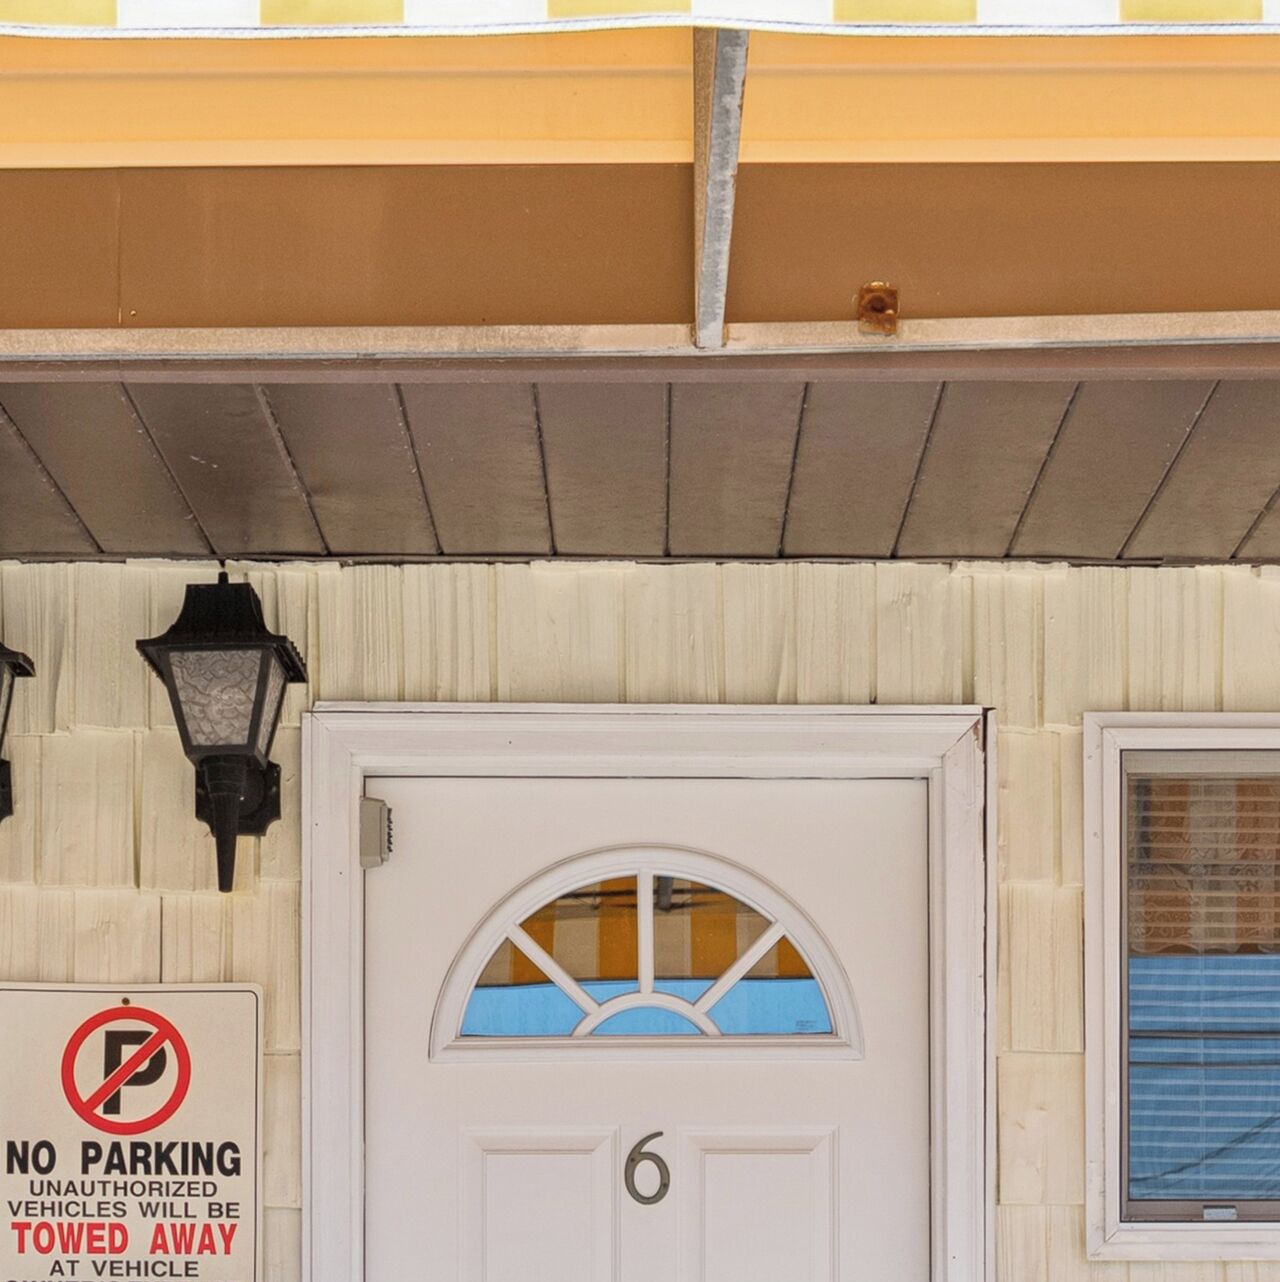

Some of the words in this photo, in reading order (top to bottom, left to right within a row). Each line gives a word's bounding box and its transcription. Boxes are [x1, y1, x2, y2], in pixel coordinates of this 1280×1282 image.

[103, 1030, 167, 1115] P
[6, 1140, 57, 1175] NO
[81, 1141, 241, 1177] PARKING
[624, 1131, 671, 1205] 6
[29, 1179, 218, 1198] UNAUTHORIZED
[7, 1200, 127, 1218] VEHICLES
[138, 1201, 197, 1218] WILL
[207, 1202, 240, 1219] BE
[11, 1221, 129, 1255] TOWED
[149, 1223, 238, 1256] AWAY
[49, 1260, 78, 1277] AT
[92, 1260, 199, 1278] VEHICLE
